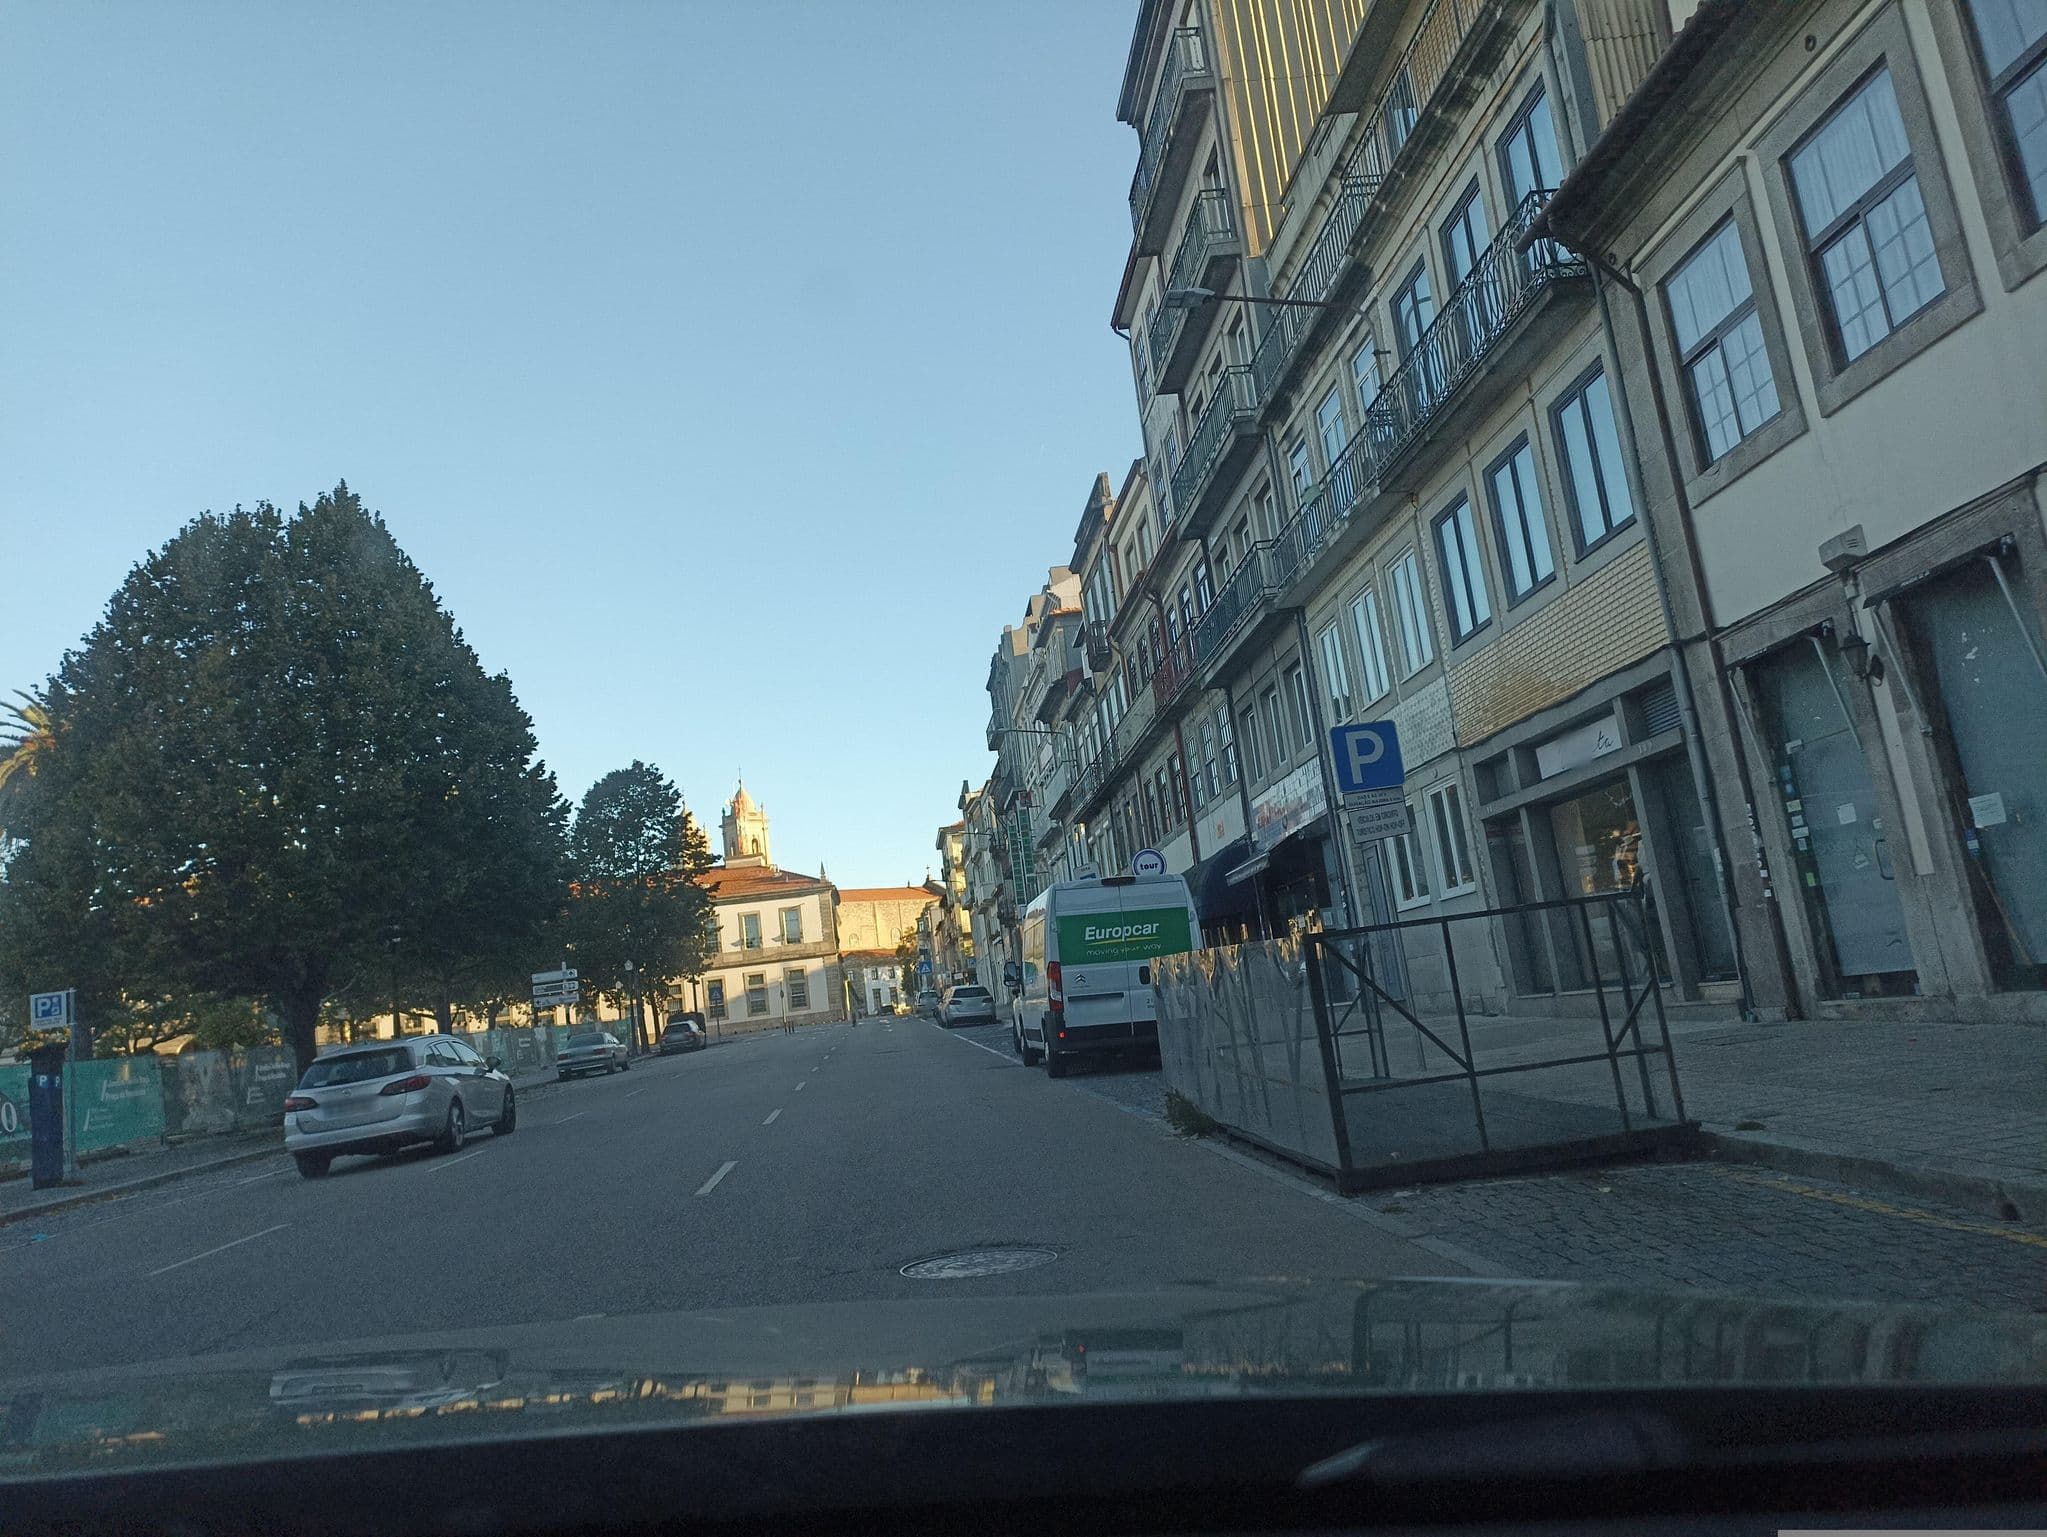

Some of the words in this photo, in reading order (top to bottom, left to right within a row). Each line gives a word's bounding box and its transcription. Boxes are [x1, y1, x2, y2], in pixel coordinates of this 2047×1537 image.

[1345, 730, 1385, 785] P
[1139, 862, 1159, 871] tour
[1084, 923, 1160, 942] Europcar
[1086, 946, 1119, 957] moving
[1143, 942, 1162, 951] way
[36, 998, 51, 1018] P
